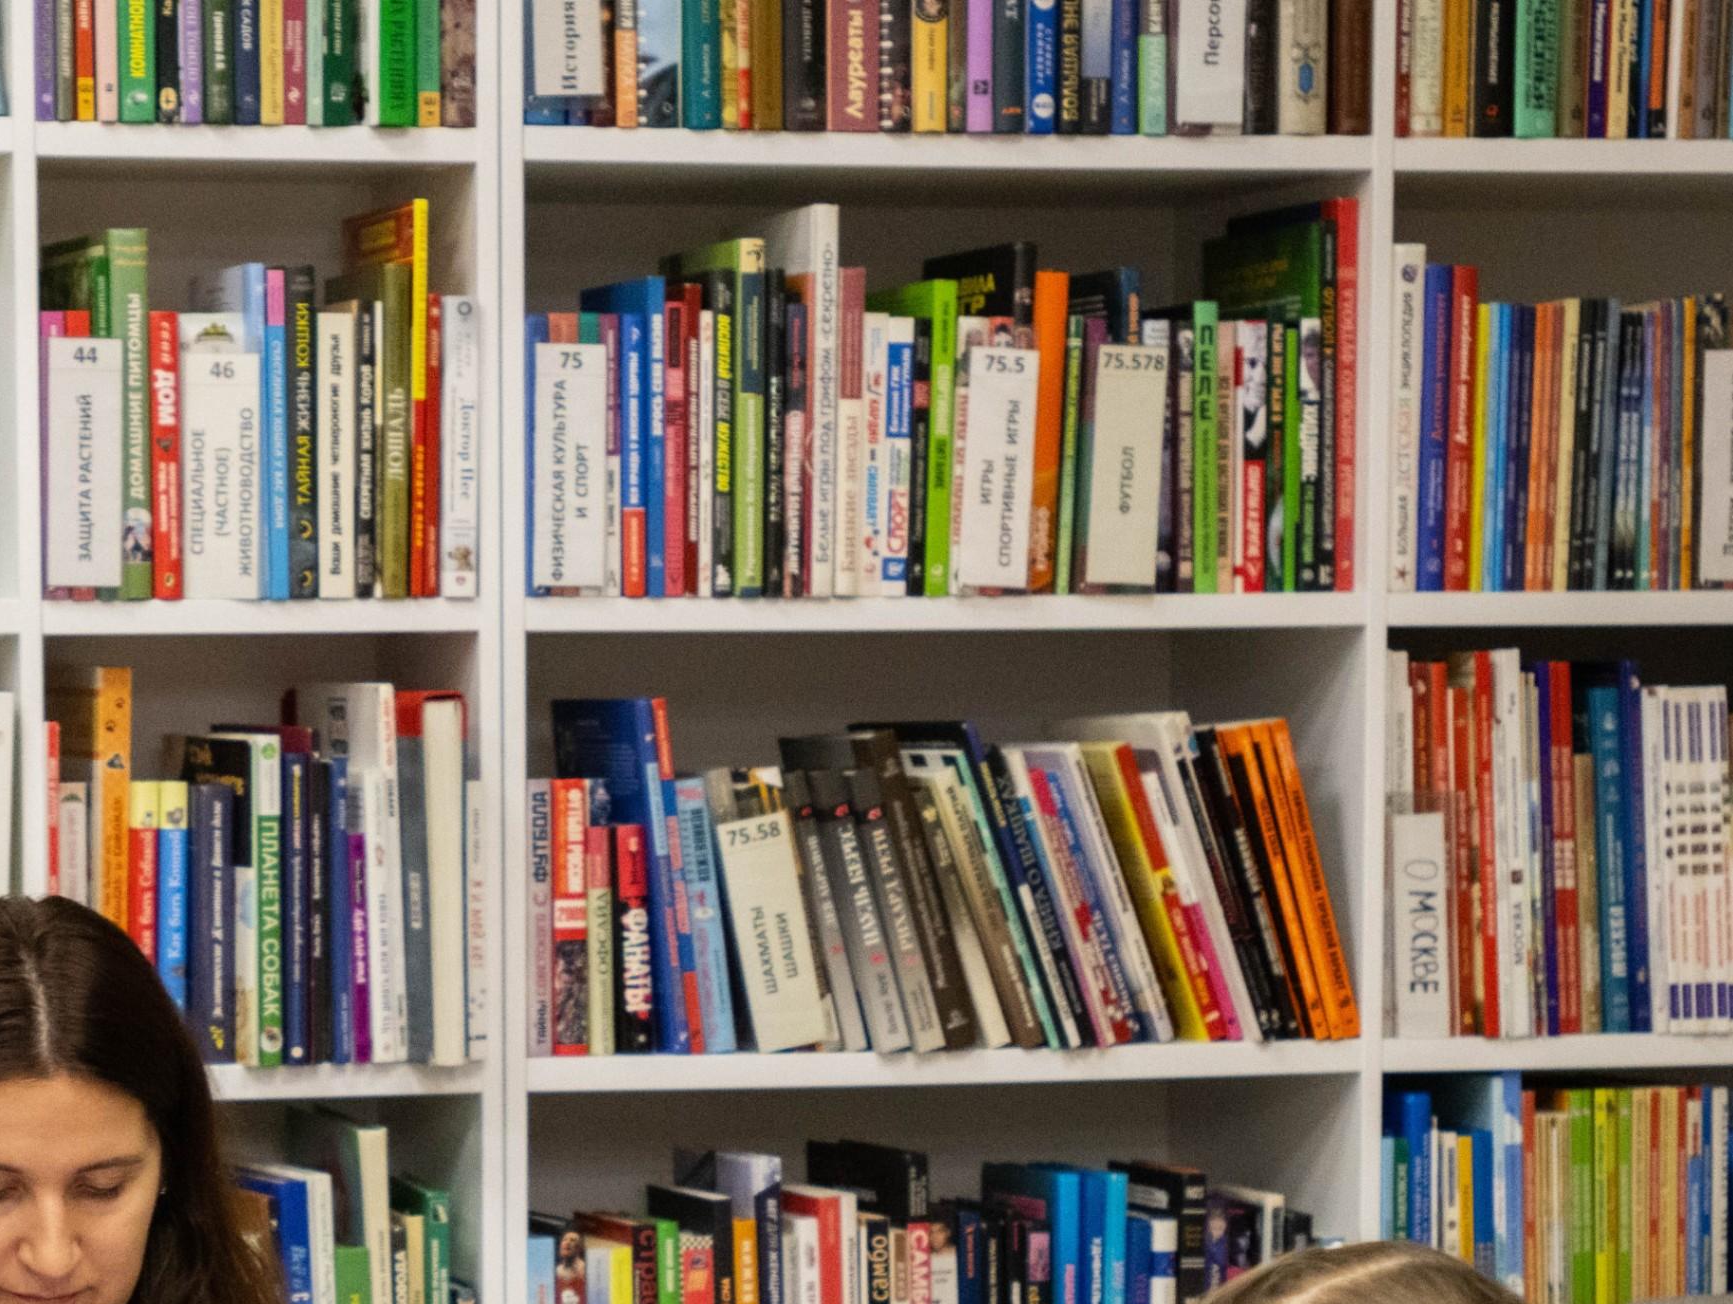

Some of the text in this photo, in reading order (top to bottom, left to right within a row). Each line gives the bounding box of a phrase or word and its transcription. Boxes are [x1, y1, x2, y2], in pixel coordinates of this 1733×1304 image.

[560, 0, 579, 90] История
[845, 9, 867, 119] Лауреаты
[1062, 34, 1081, 121] БОЛЬШАЯ
[72, 345, 98, 364] 44
[210, 360, 235, 379] 46
[559, 351, 583, 369] 75
[717, 314, 731, 380] ВОСПИТАЙ
[984, 354, 1026, 373] 75.5
[1103, 352, 1166, 372] 75.578
[124, 293, 145, 500] ДОМАШНИЕ ПИТОМЦЫ
[153, 368, 176, 427] ДОМ
[294, 302, 312, 506] ТАЙНАЯ ЖИЗНЬ КОШКИ
[387, 386, 406, 481] ЛОШАДЬ
[75, 393, 93, 563] ЗАЩИТА РАСТЕНИЙ
[190, 428, 206, 556] СПЕЦИАЛЬНОЕ
[213, 447, 231, 538] (ЧАСТНОЕ)
[239, 407, 255, 577] ЖИВОТНОВОДСТВО
[329, 333, 343, 576] Ваши домашние четвероногие друзья
[550, 379, 567, 582] ФИЗИЧЕСКАЯ КУЛЬТУРА
[575, 442, 590, 519] И СПОРТ
[717, 421, 731, 492] МУЖЕСТВО
[815, 345, 835, 563] Белые игры под грифом
[842, 415, 860, 573] Близкие звезды
[979, 459, 994, 505] ИГРЫ
[998, 399, 1021, 568] СПОРТИВНЫЕ ИГРЫ
[1118, 446, 1136, 514] ФУТБОЛ
[533, 790, 549, 882] ФУТБОЛА
[725, 821, 781, 847] 75.58
[873, 827, 895, 875] РЕТИ
[260, 820, 281, 1017] ПЛАНЕТА СОБАК
[838, 825, 879, 946] ПАУЛЬ КЕРЕС
[887, 878, 914, 951] РИХАРД
[1404, 857, 1440, 994] О МОСКВЕ
[595, 889, 610, 975] ОФСАЙД
[621, 906, 651, 1013] ФАНАТЫ
[750, 905, 779, 994] ШАХМАТЫ
[775, 912, 799, 978] ШАШКИ
[870, 1234, 890, 1302] самбо
